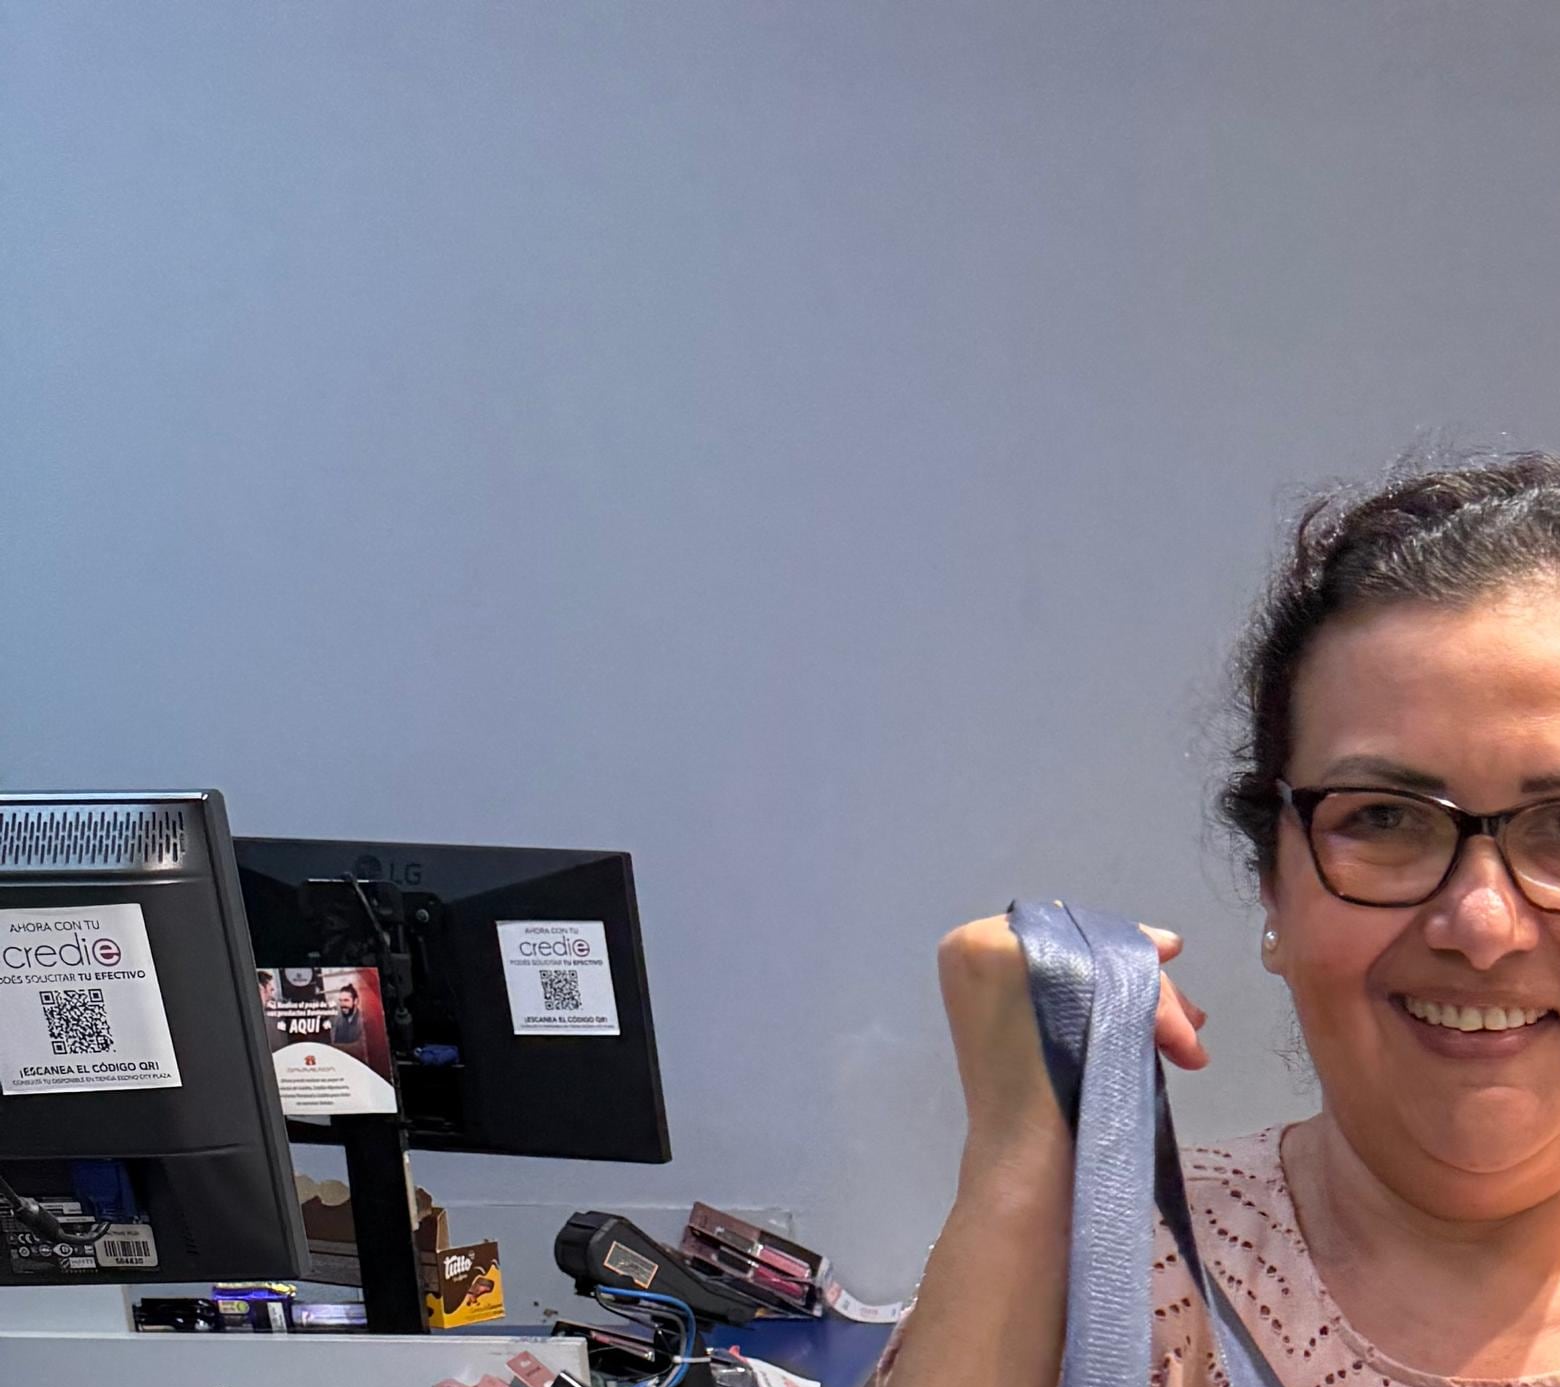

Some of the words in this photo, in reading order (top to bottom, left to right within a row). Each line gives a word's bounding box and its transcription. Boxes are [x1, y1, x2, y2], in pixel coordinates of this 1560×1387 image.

[390, 863, 421, 886] LG
[10, 923, 51, 932] AHORA
[55, 921, 81, 931] CON
[84, 920, 100, 930] TU
[3, 932, 122, 969] credie
[519, 935, 591, 957] credie
[25, 973, 77, 983] SOLICITAR
[78, 972, 92, 981] TU
[95, 970, 146, 981] EFECTIVO
[289, 1015, 321, 1035] AQUÍ
[77, 1065, 90, 1074] EL
[92, 1062, 137, 1073] CÓDIGO
